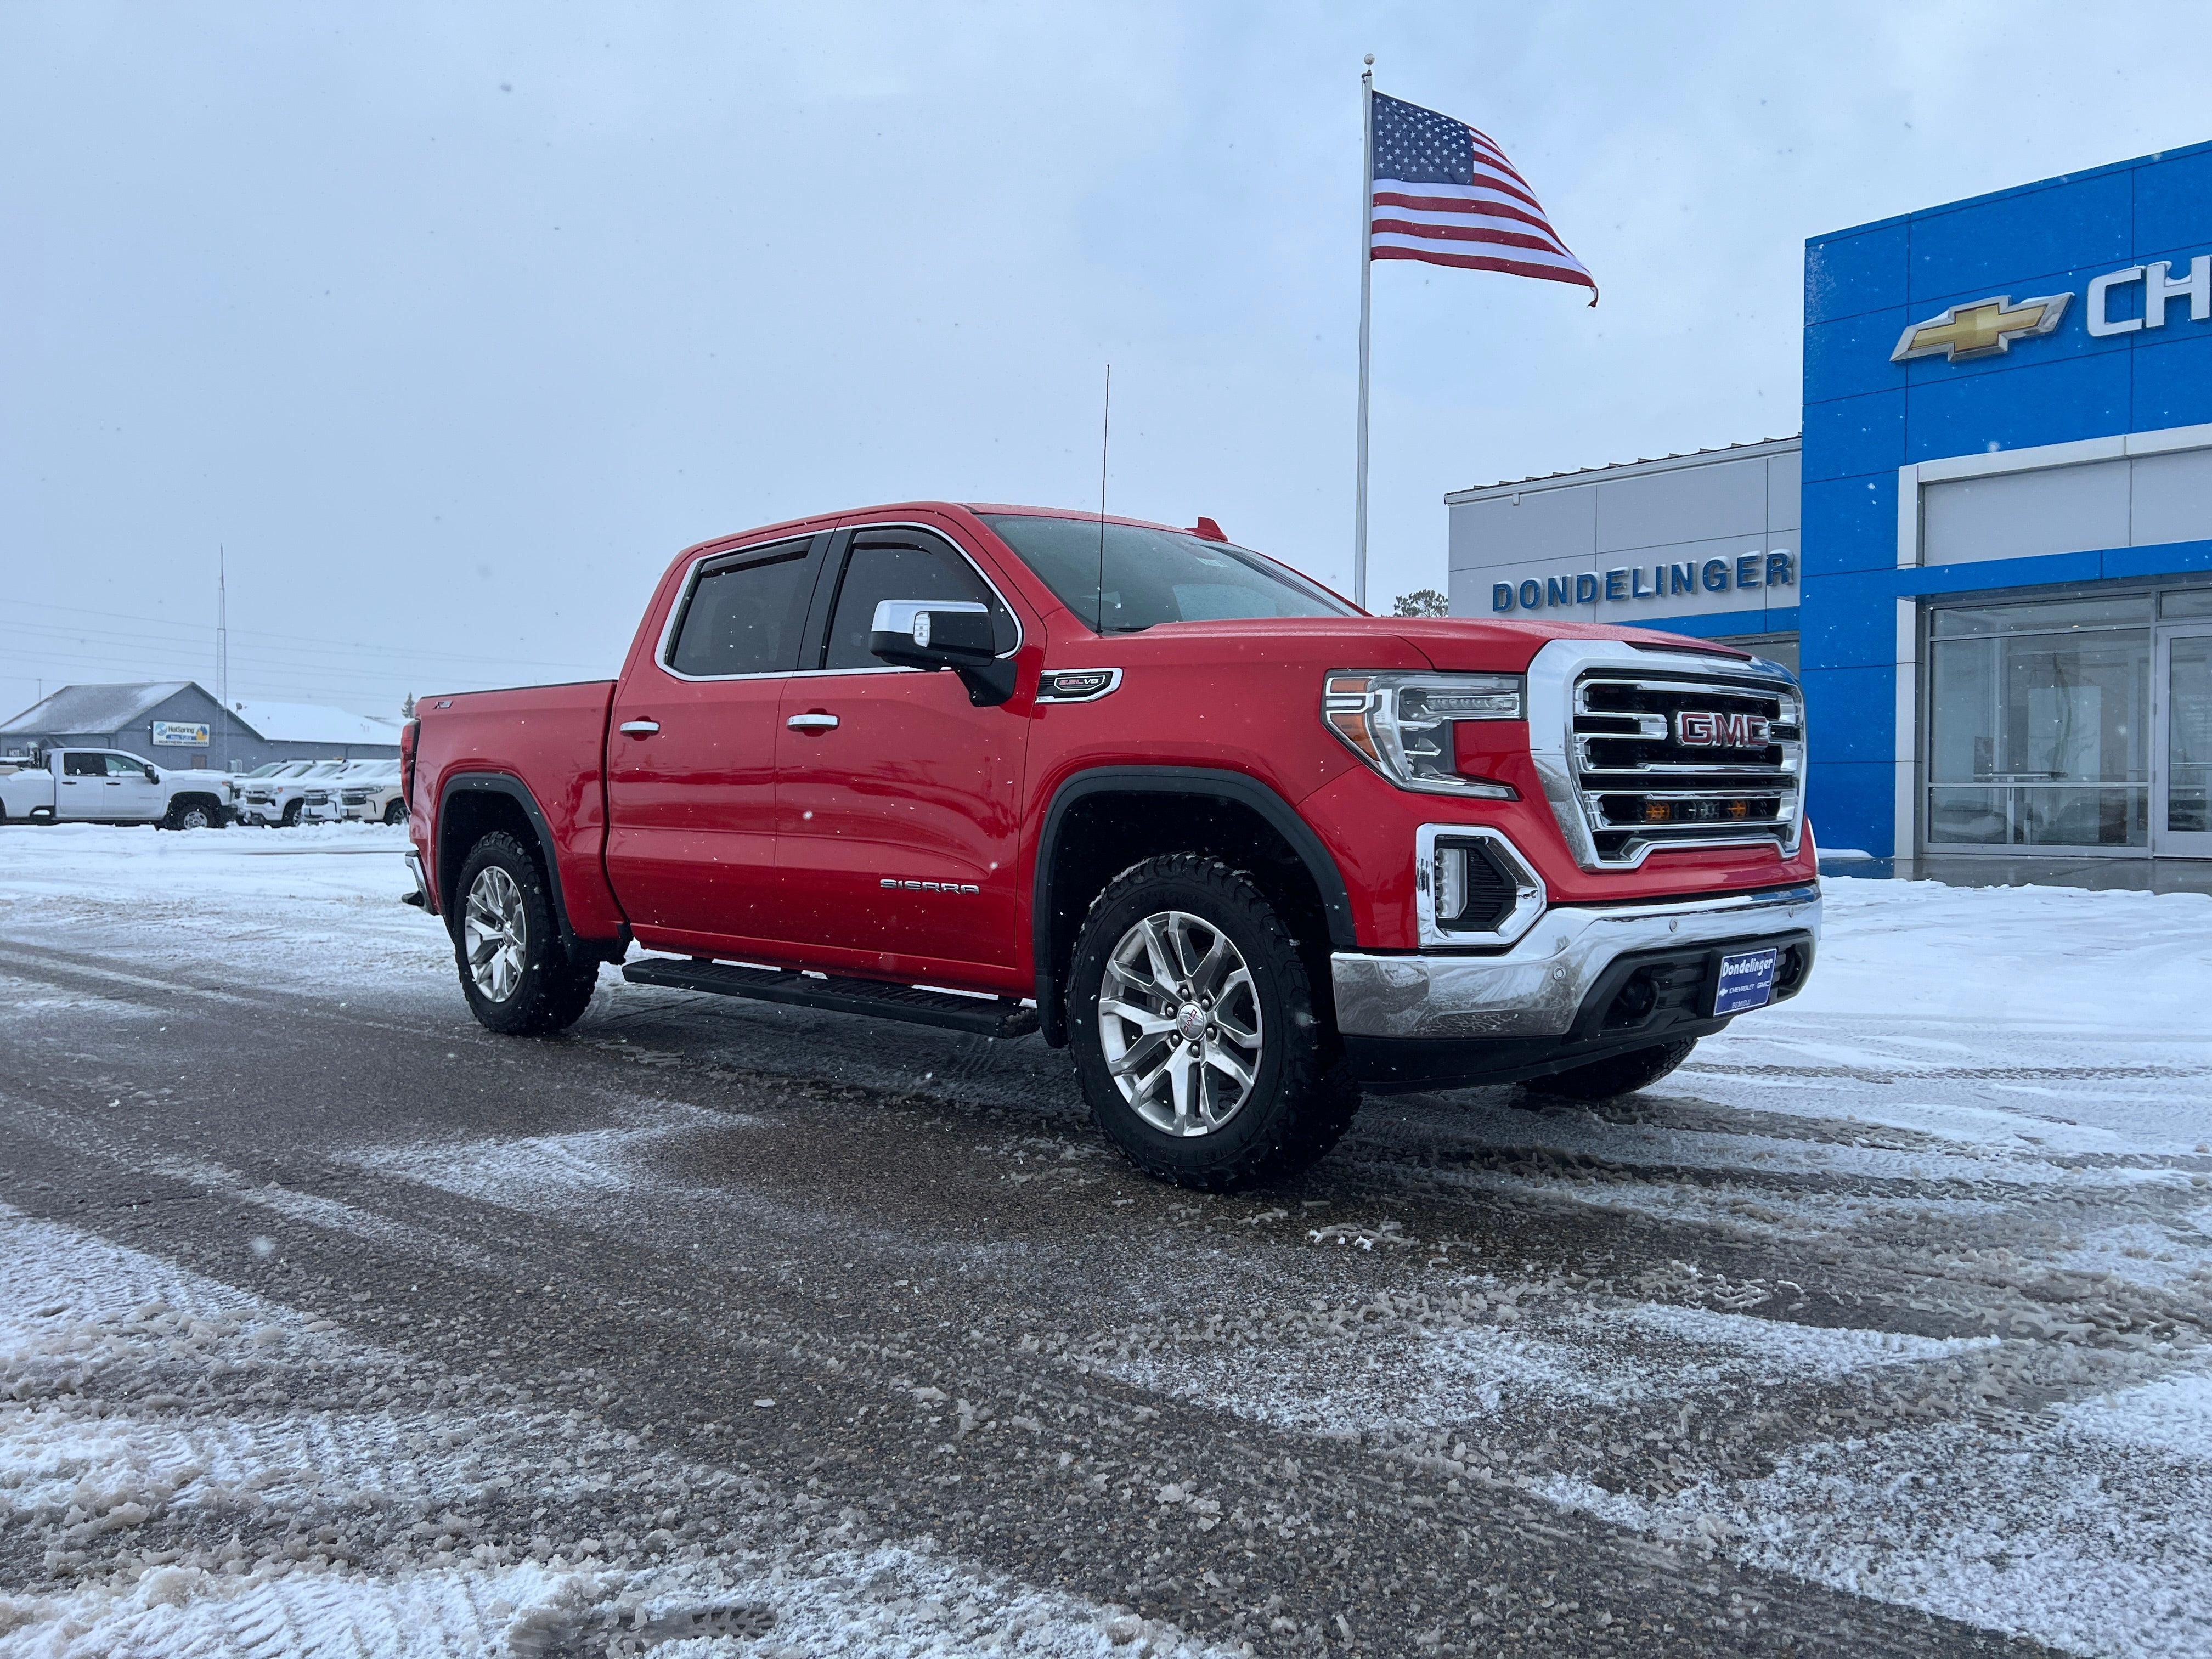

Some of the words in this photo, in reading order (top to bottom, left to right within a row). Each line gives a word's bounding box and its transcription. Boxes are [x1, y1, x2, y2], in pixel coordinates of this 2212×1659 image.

[2087, 255, 2211, 337] CH
[1492, 549, 1795, 612] DONDELINGER
[1676, 711, 1769, 748] GMC
[879, 879, 980, 895] SIERRA
[1722, 958, 1773, 978] Dondelinger
[1729, 984, 1755, 994] CHEVROLET
[1757, 980, 1770, 989] GMC
[1183, 1009, 1197, 1035] GMC
